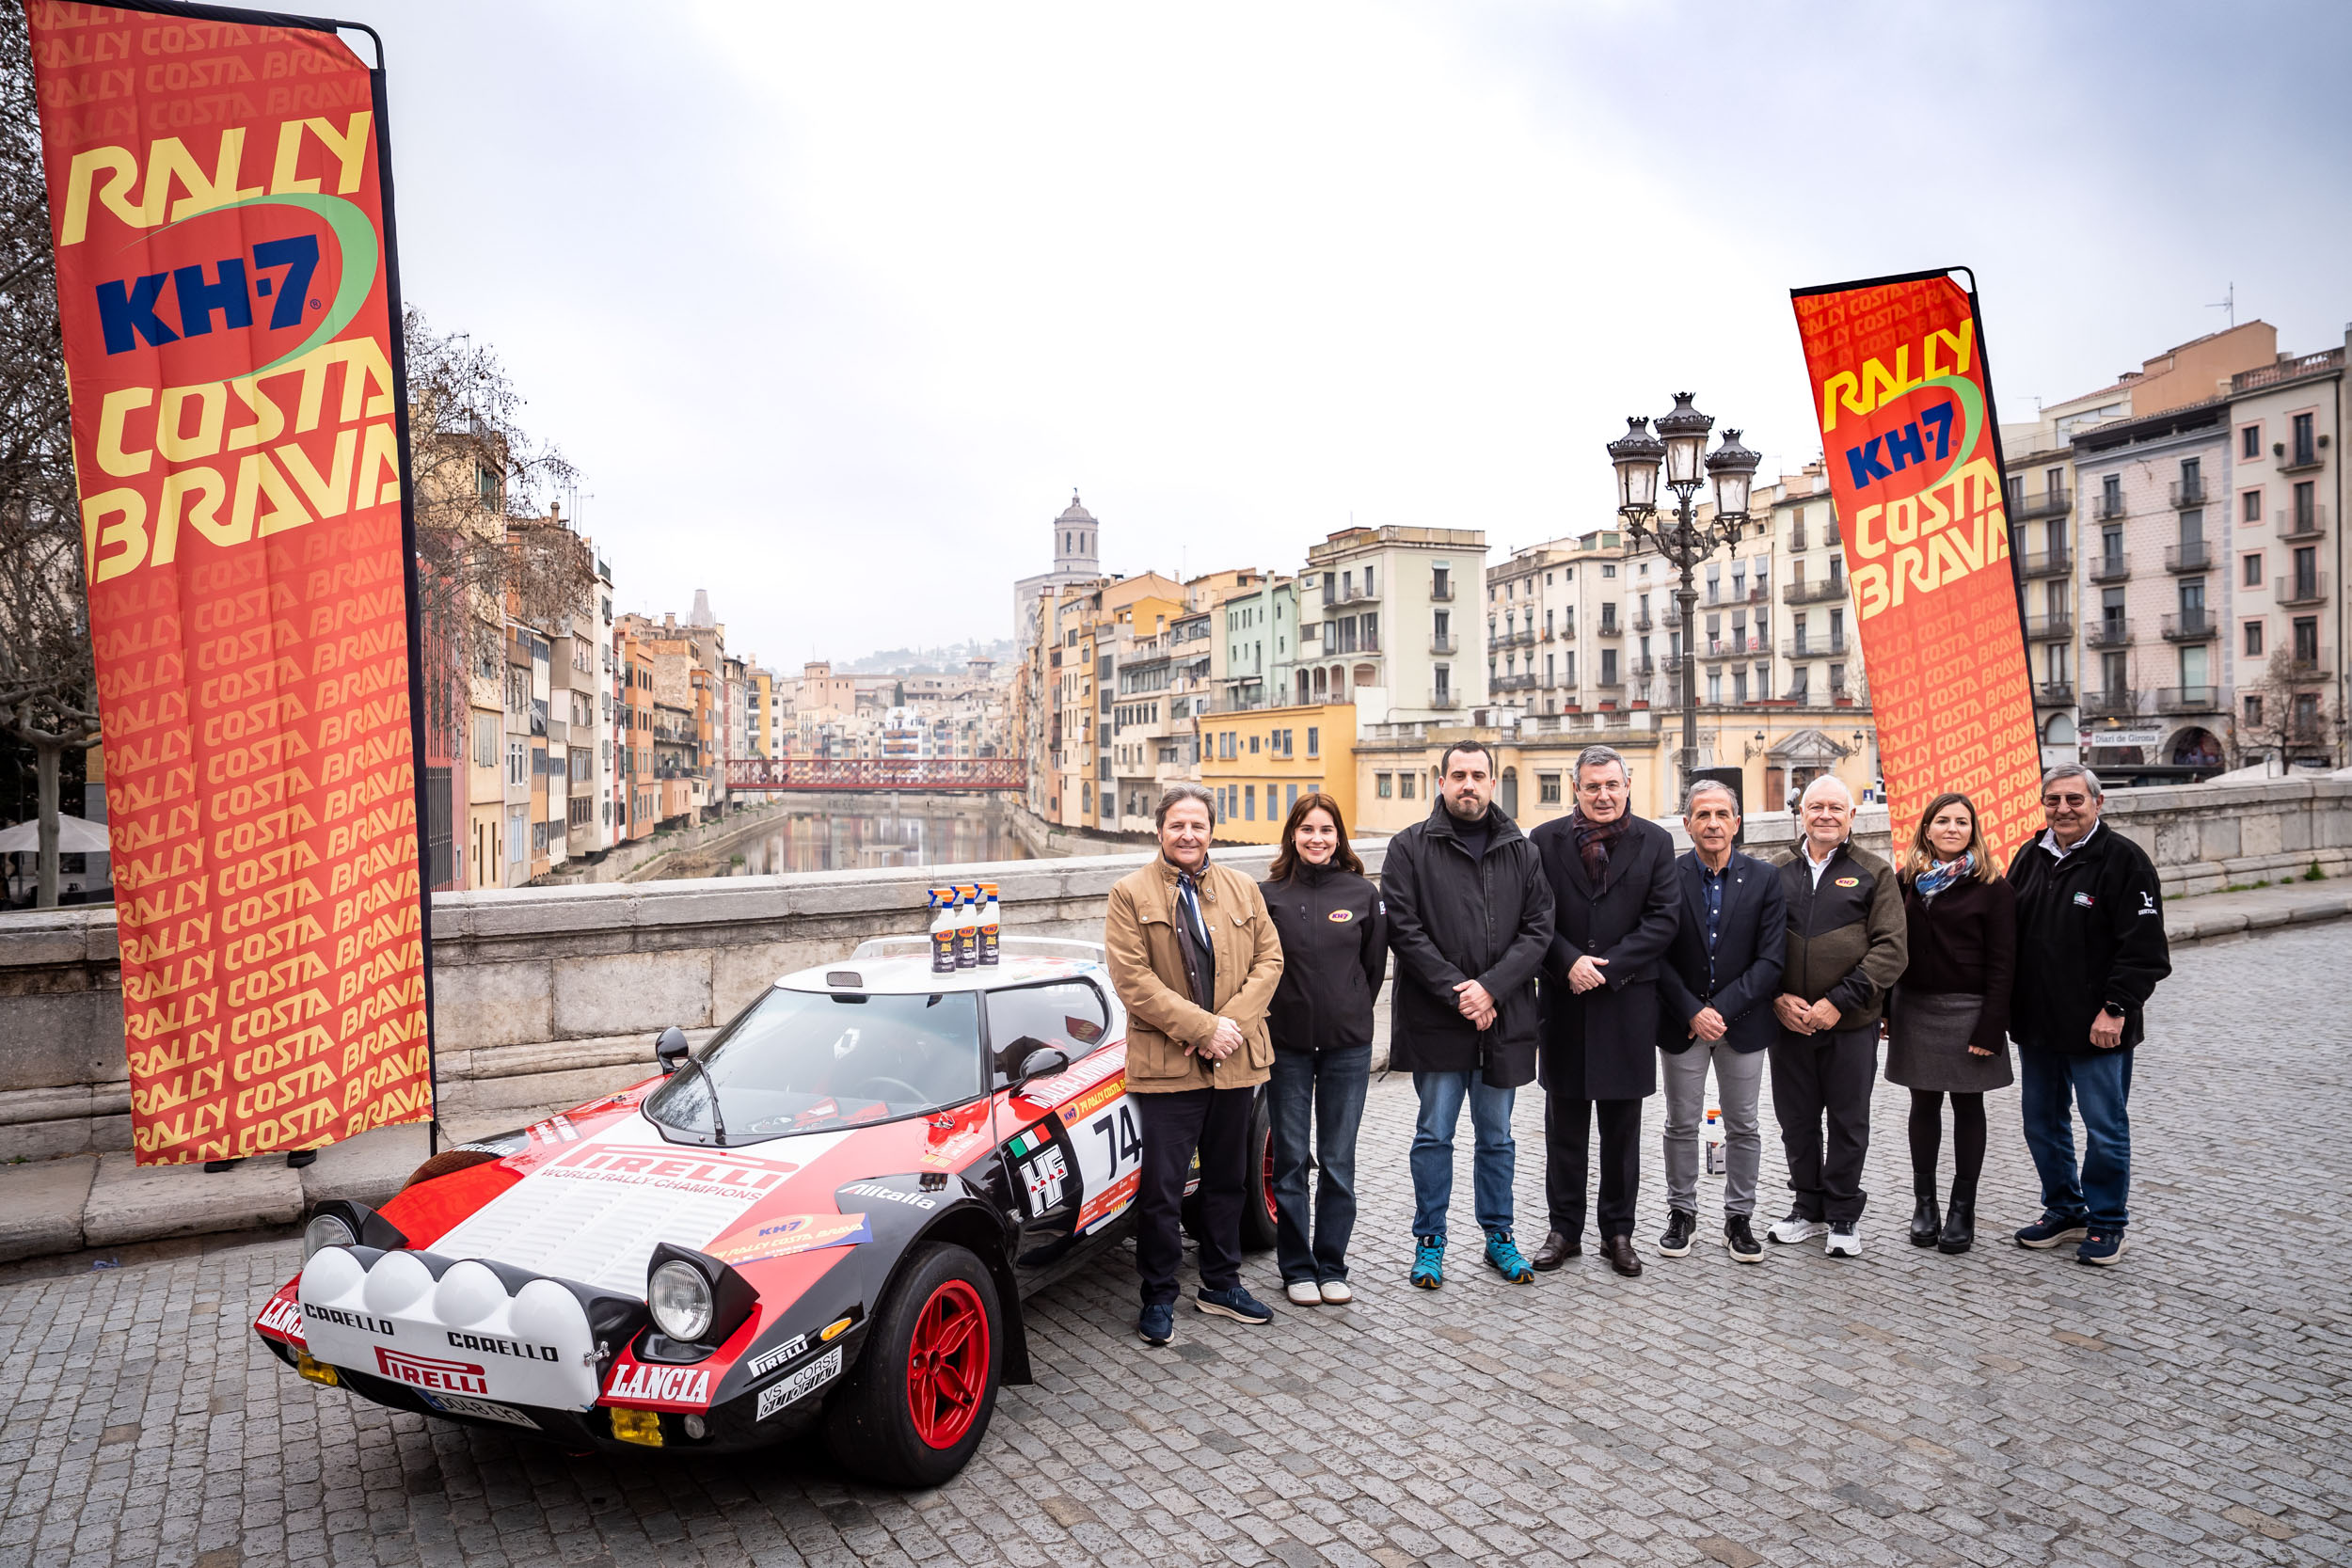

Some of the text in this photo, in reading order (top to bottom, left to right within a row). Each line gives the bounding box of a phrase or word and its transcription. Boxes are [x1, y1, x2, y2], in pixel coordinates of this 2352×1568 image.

[142, 21, 253, 55] COSTA
[146, 55, 256, 93] COSTA
[149, 91, 259, 131] COSTA
[60, 110, 373, 246] RALLY
[96, 234, 320, 356] KH-7
[1850, 284, 1904, 316] COSTA
[1854, 302, 1910, 336] COSTA
[96, 336, 396, 478] COSTA
[1823, 317, 1973, 434] RALLY
[1846, 401, 1954, 490] KH-7
[81, 422, 402, 587] BRAVA
[1855, 456, 2003, 560] COSTA
[194, 581, 299, 632] COSTA
[305, 549, 402, 602] BRAVA
[1850, 508, 2010, 622] BRAVA
[197, 619, 303, 671] COSTA
[309, 585, 405, 639] BRAVA
[1917, 610, 1967, 643] COSTA
[1921, 632, 1972, 666] COSTA
[200, 656, 306, 709] COSTA
[312, 621, 407, 675] BRAVA
[203, 692, 309, 747] COSTA
[314, 657, 408, 713] BRAVA
[1925, 655, 1976, 689] COSTA
[1929, 676, 1979, 710] COSTA
[207, 730, 311, 784] COSTA
[317, 692, 410, 750] BRAVA
[1932, 698, 1983, 733] COSTA
[1936, 721, 1987, 755] COSTA
[2095, 735, 2115, 743] Diari
[2128, 734, 2156, 742] Girona
[211, 766, 314, 822] COSTA
[320, 727, 413, 786] BRAVA
[1940, 742, 1990, 778] COSTA
[215, 803, 318, 859] COSTA
[324, 763, 415, 823] BRAVA
[218, 840, 321, 896] COSTA
[326, 798, 417, 861] BRAVA
[221, 877, 324, 933] COSTA
[329, 833, 419, 897] BRAVA
[224, 913, 326, 971] COSTA
[332, 869, 421, 933] BRAVA
[228, 951, 329, 1007] COSTA
[335, 904, 422, 971] BRAVA
[230, 988, 332, 1044] COSTA
[337, 940, 423, 1006] BRAVA
[233, 1024, 335, 1082] COSTA
[340, 974, 425, 1042] BRAVA
[235, 1061, 337, 1119] COSTA
[342, 1009, 428, 1078] BRAVA
[238, 1097, 339, 1153] COSTA
[343, 1045, 430, 1113] BRAVA
[1088, 1090, 1105, 1110] RALLY
[1104, 1082, 1122, 1100] COSTA
[554, 1144, 800, 1191] PIRELLI
[1019, 1144, 1068, 1218] HF
[1092, 1104, 1143, 1182] 74
[542, 1168, 763, 1202] WORLD RALLY CHAMPIONS
[837, 1183, 937, 1211] Alitalia
[727, 1241, 770, 1259] RALLY
[771, 1232, 814, 1246] COSTA
[816, 1222, 864, 1239] BRAVA
[304, 1303, 559, 1362] CARELLO CARELLO
[373, 1345, 488, 1395] PIRELLI
[747, 1333, 809, 1378] PIRELLI
[607, 1364, 712, 1403] LANCIA
[764, 1349, 839, 1403] VS CORSE
